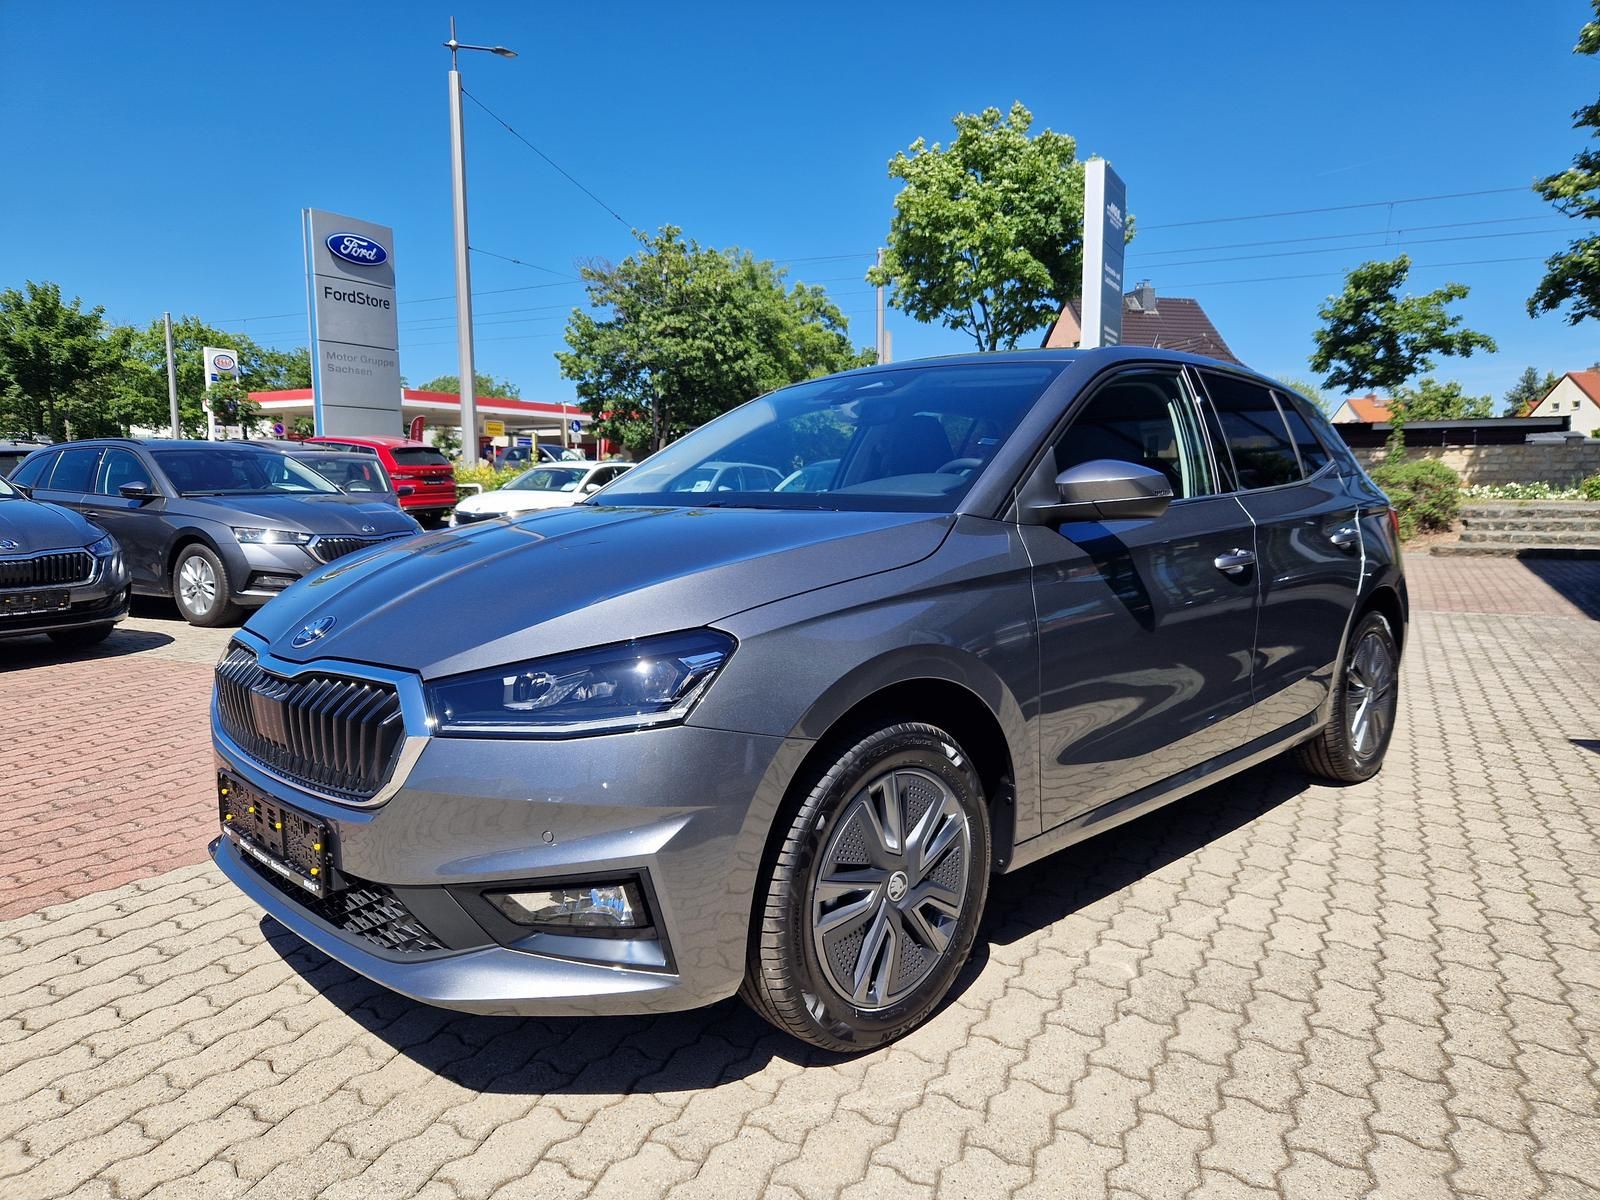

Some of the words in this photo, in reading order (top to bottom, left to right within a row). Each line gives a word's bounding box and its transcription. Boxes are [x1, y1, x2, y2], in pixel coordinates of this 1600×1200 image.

[340, 237, 377, 260] Ford
[324, 286, 391, 309] FordStore
[326, 351, 357, 362] Motor
[360, 355, 395, 367] Gruppe
[327, 363, 373, 376] Sachsen
